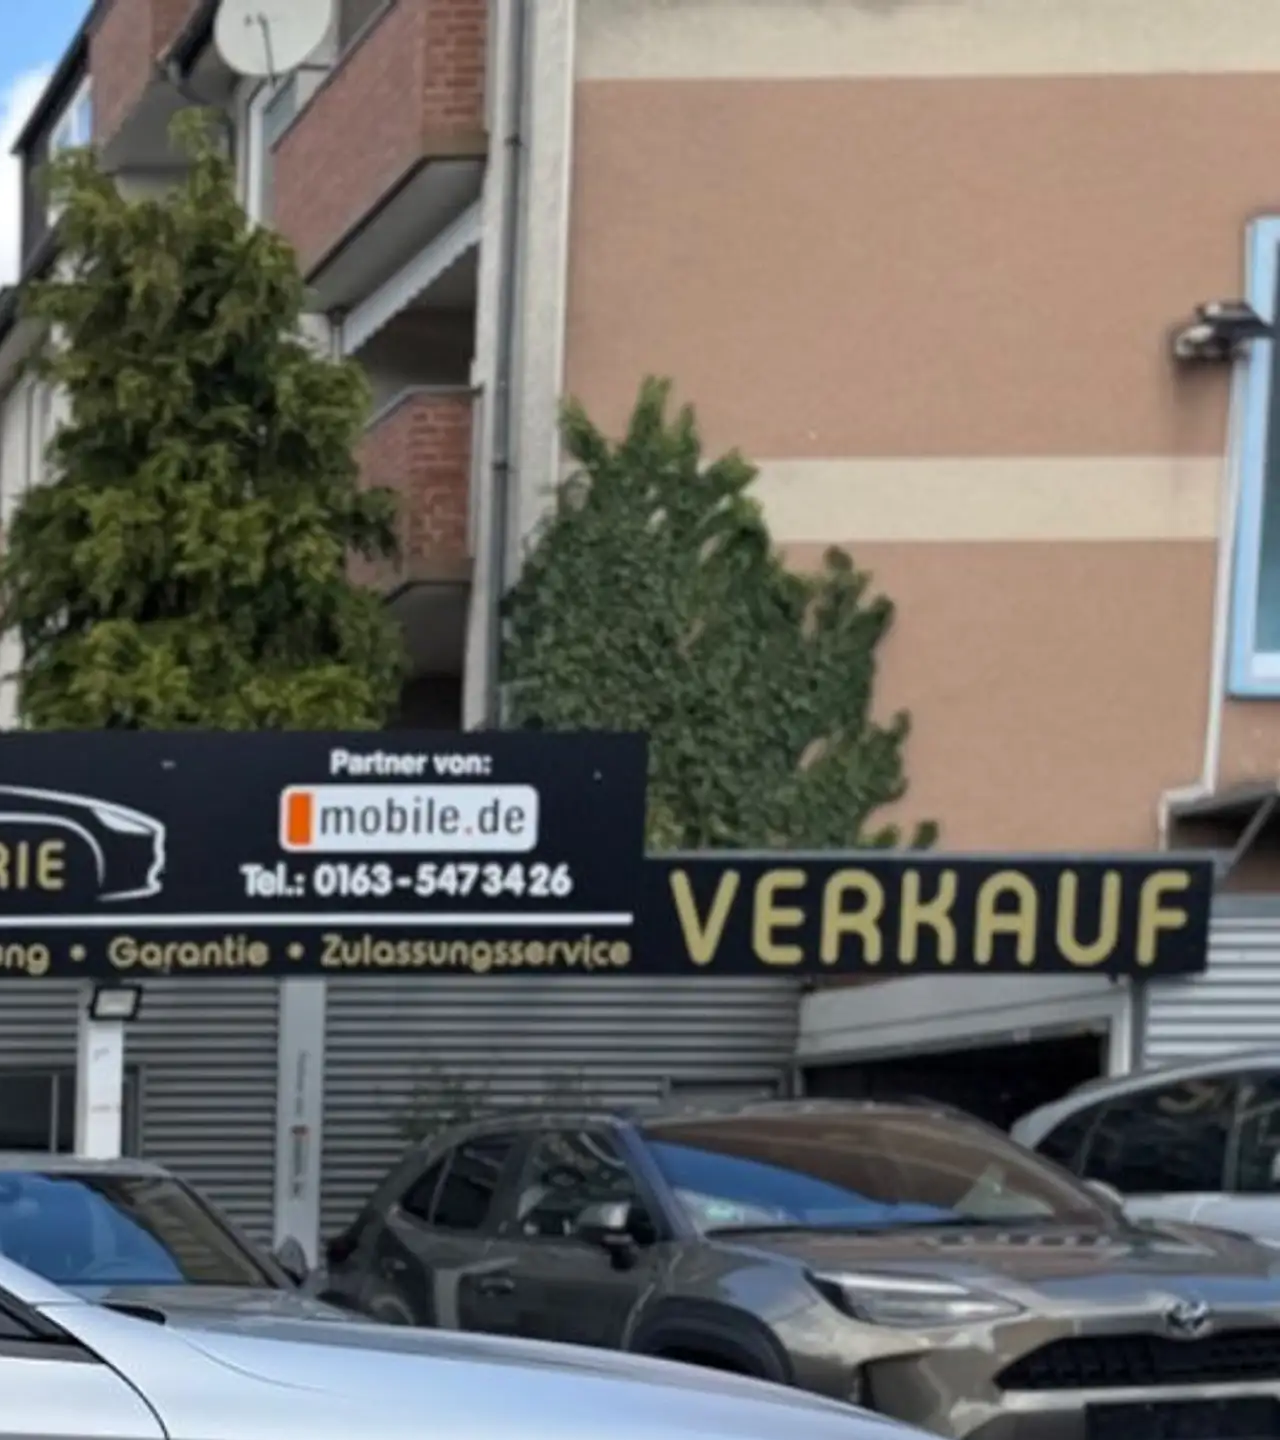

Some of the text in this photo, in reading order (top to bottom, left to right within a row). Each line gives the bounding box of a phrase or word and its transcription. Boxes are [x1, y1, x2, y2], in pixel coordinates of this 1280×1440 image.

[329, 749, 493, 776] Partner von:
[319, 797, 526, 836] mobile.de
[239, 862, 573, 897] Tel.: 0163-5473426
[669, 868, 1192, 967] VERKAUF
[108, 936, 269, 969] Garantie
[320, 934, 632, 974] Zulassungsservice
